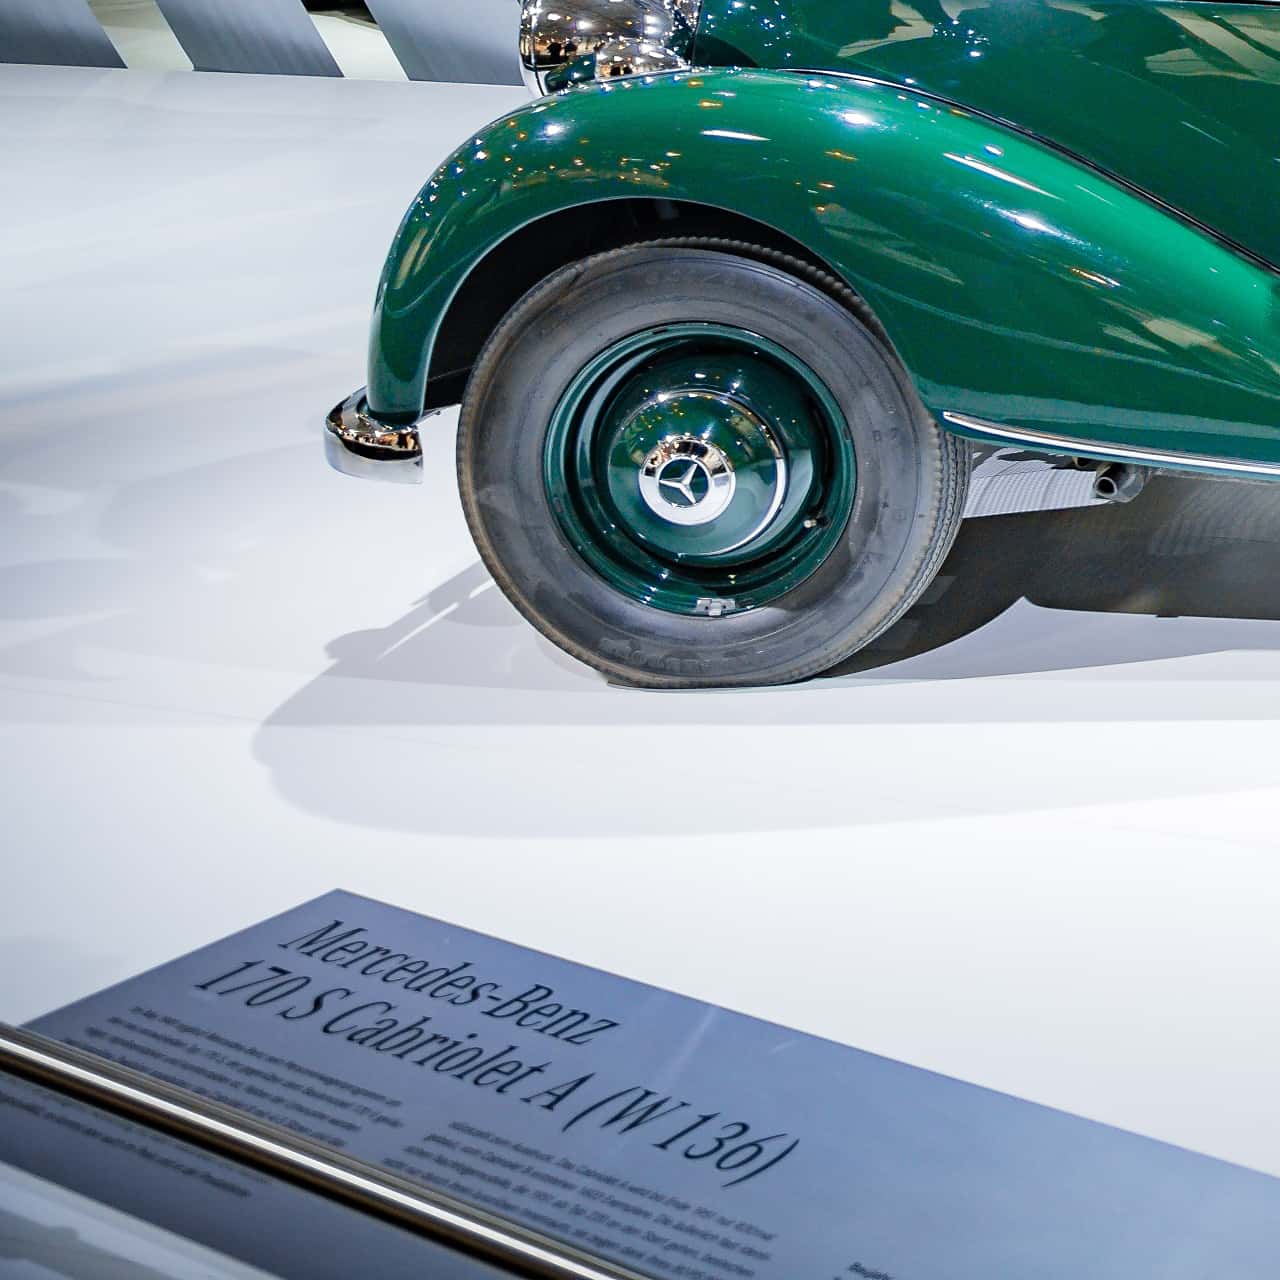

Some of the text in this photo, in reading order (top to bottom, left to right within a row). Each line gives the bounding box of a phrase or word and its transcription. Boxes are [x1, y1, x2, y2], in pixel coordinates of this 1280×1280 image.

[277, 919, 620, 1045] Mercedes-Benz
[194, 959, 801, 1188] 170 S Cabriolet A (W 136)
